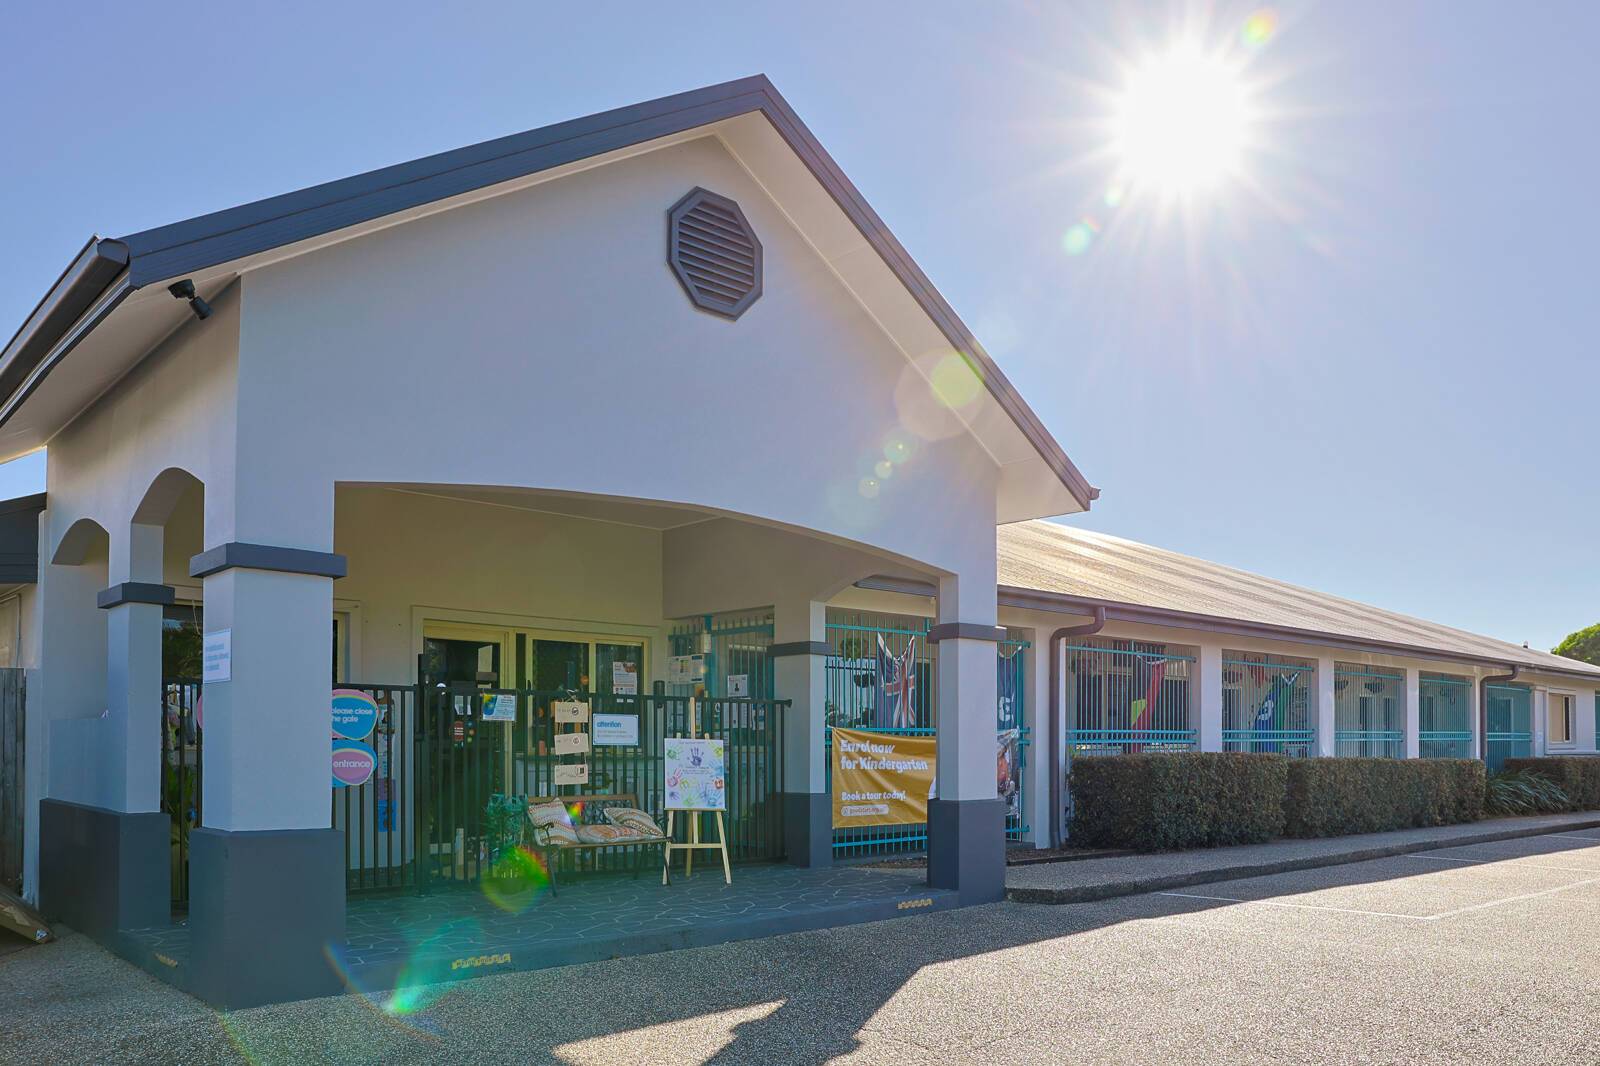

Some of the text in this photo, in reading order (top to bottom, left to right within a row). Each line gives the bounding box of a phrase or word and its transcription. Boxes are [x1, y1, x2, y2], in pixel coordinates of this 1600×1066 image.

[841, 740, 895, 753] Enrol now
[333, 760, 370, 768] entrance
[841, 756, 928, 772] for Kindergarten
[841, 791, 860, 800] Book
[883, 790, 906, 801] today!
